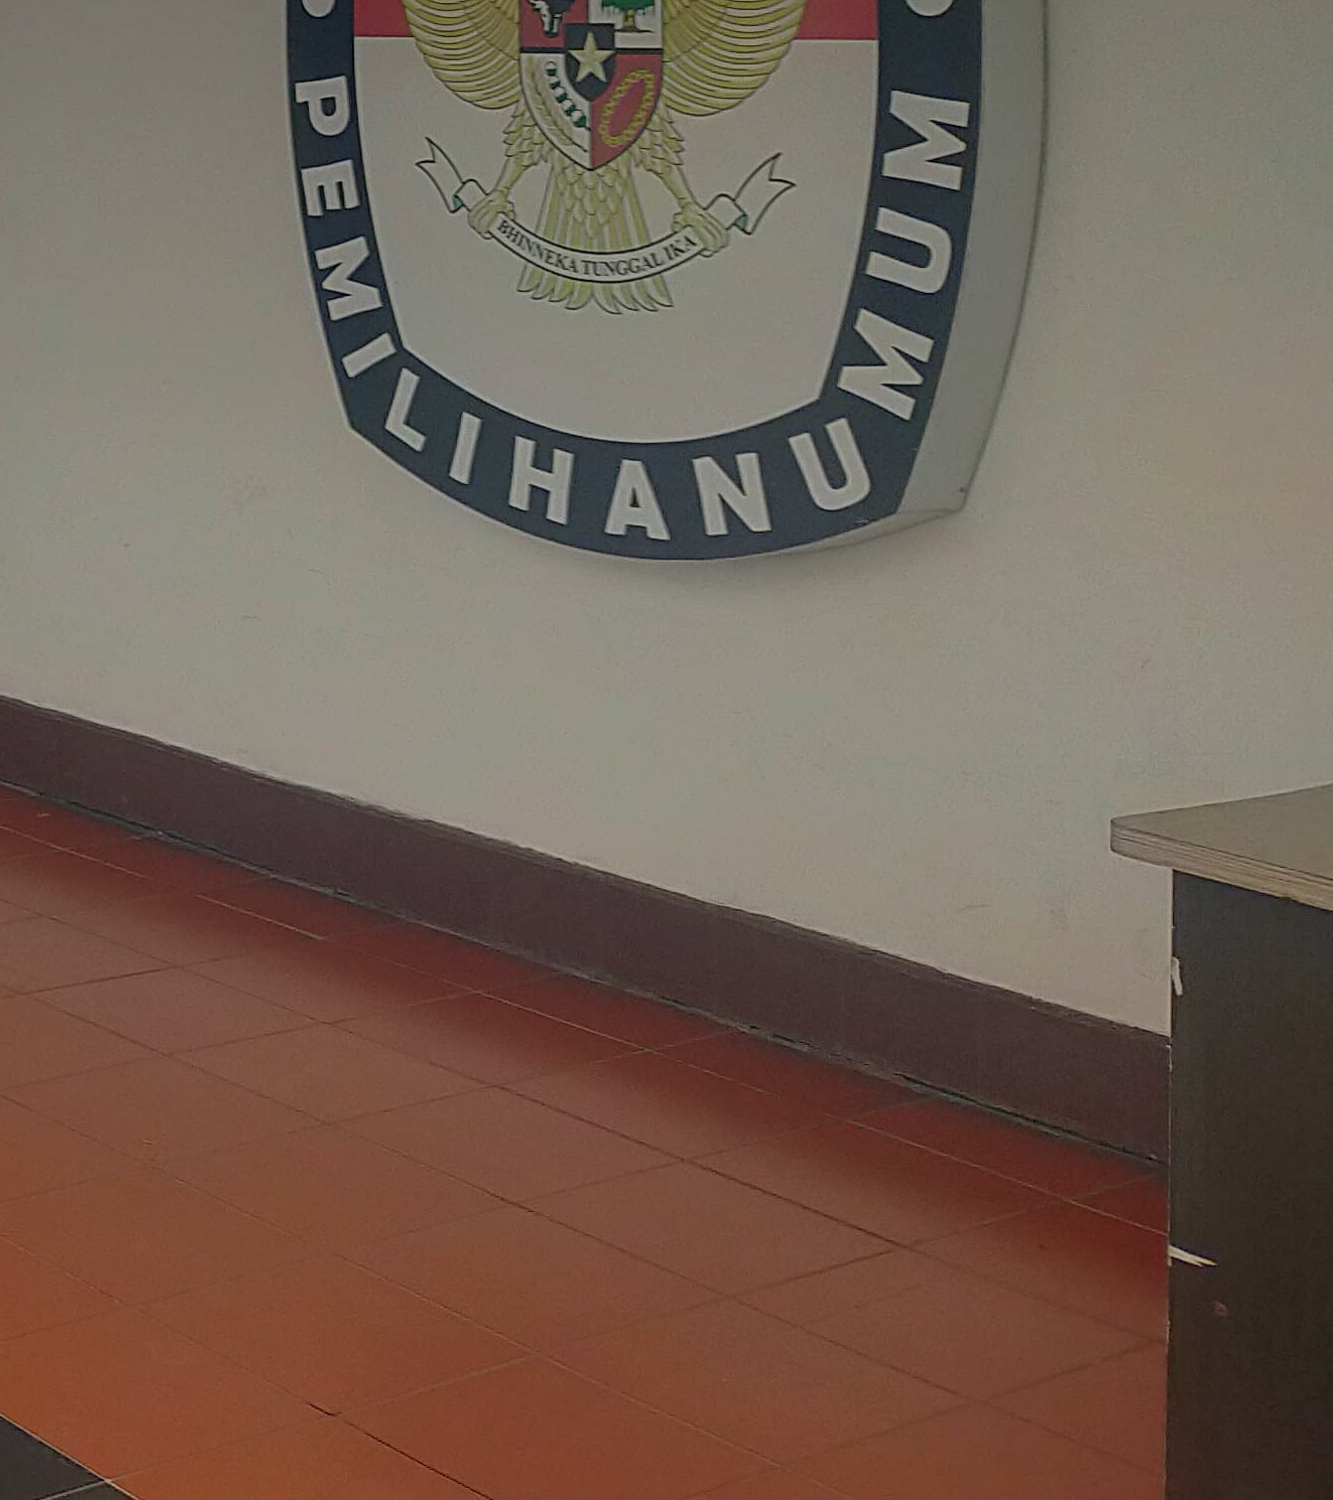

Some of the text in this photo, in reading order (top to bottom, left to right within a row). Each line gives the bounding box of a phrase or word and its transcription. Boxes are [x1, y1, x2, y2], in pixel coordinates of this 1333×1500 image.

[293, 73, 972, 540] PEMILIHAN UMUM
[497, 219, 697, 276] BHINNEKA TUNGGAL IKA
